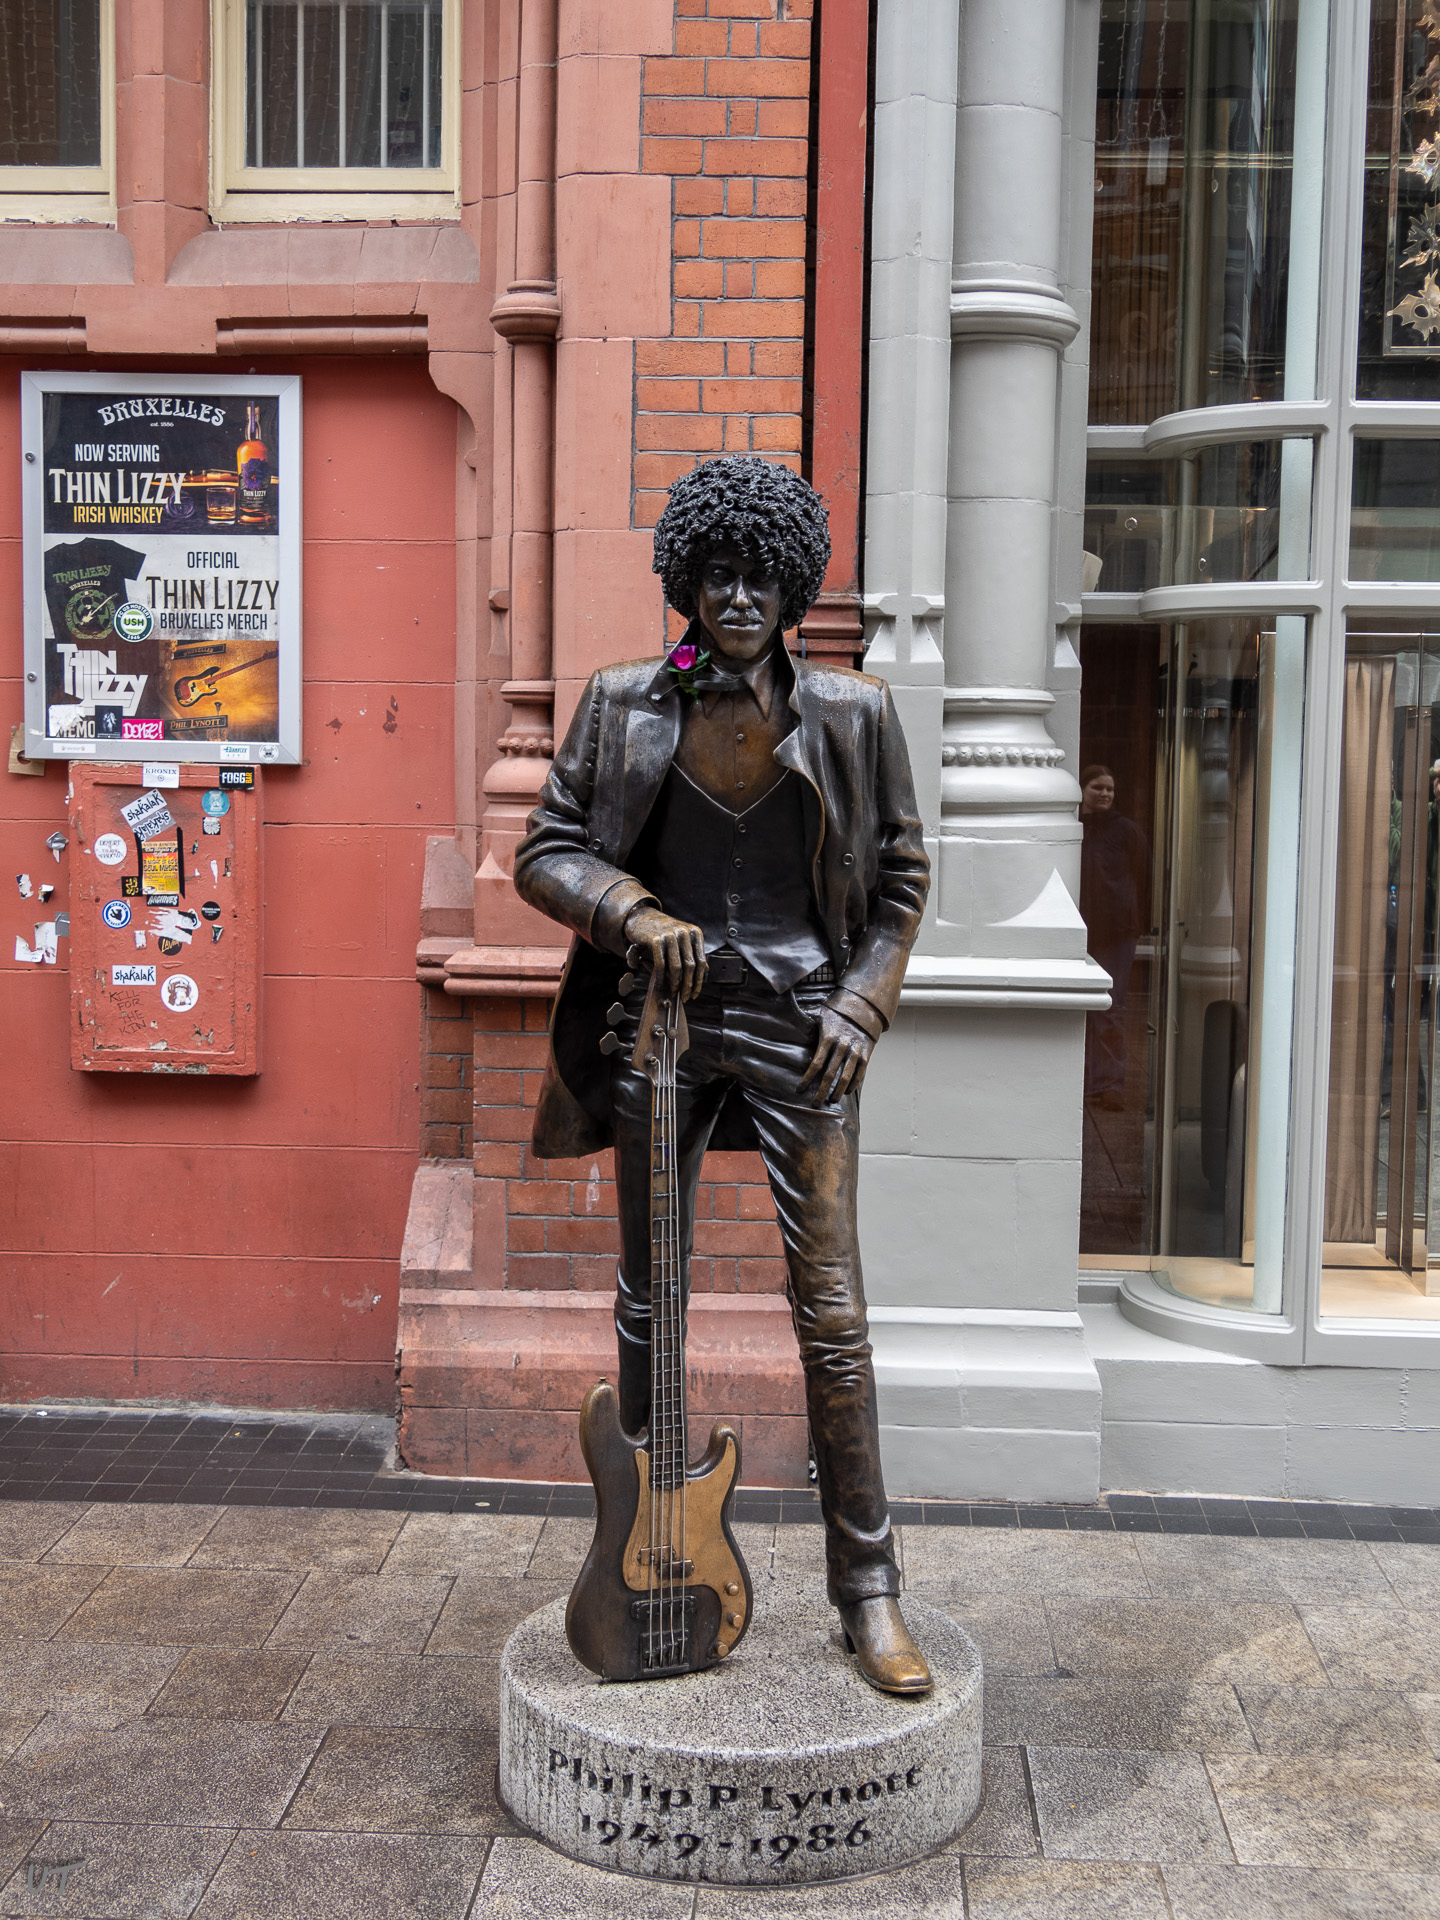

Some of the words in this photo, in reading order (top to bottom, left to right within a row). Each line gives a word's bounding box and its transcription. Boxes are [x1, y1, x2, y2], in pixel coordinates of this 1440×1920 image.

[97, 398, 226, 426] BRUXELLES
[75, 443, 105, 462] NOW
[107, 444, 160, 463] SERVING
[48, 468, 113, 504] THIN
[117, 468, 187, 505] LIZZY
[73, 506, 106, 524] IRISH
[109, 506, 163, 524] WHISKEY
[187, 551, 240, 569] OFFICIAL
[145, 576, 207, 610] THIN
[213, 576, 280, 611] LIZZY
[123, 618, 145, 627] USH
[160, 611, 224, 630] BRUXELLES
[227, 612, 268, 630] MERCH
[56, 643, 117, 699] THIN
[170, 720, 187, 730] PHIL
[190, 718, 221, 729] LYNOTT
[221, 772, 246, 784] FOGG
[245, 772, 253, 784] BAR
[116, 998, 144, 1011] FOR
[119, 1010, 144, 1024] THE
[548, 1748, 693, 1816] Philip
[708, 1784, 739, 1812] P
[760, 1764, 924, 1821] Lynott
[577, 1806, 701, 1861] 1949
[750, 1815, 874, 1868] 1986
